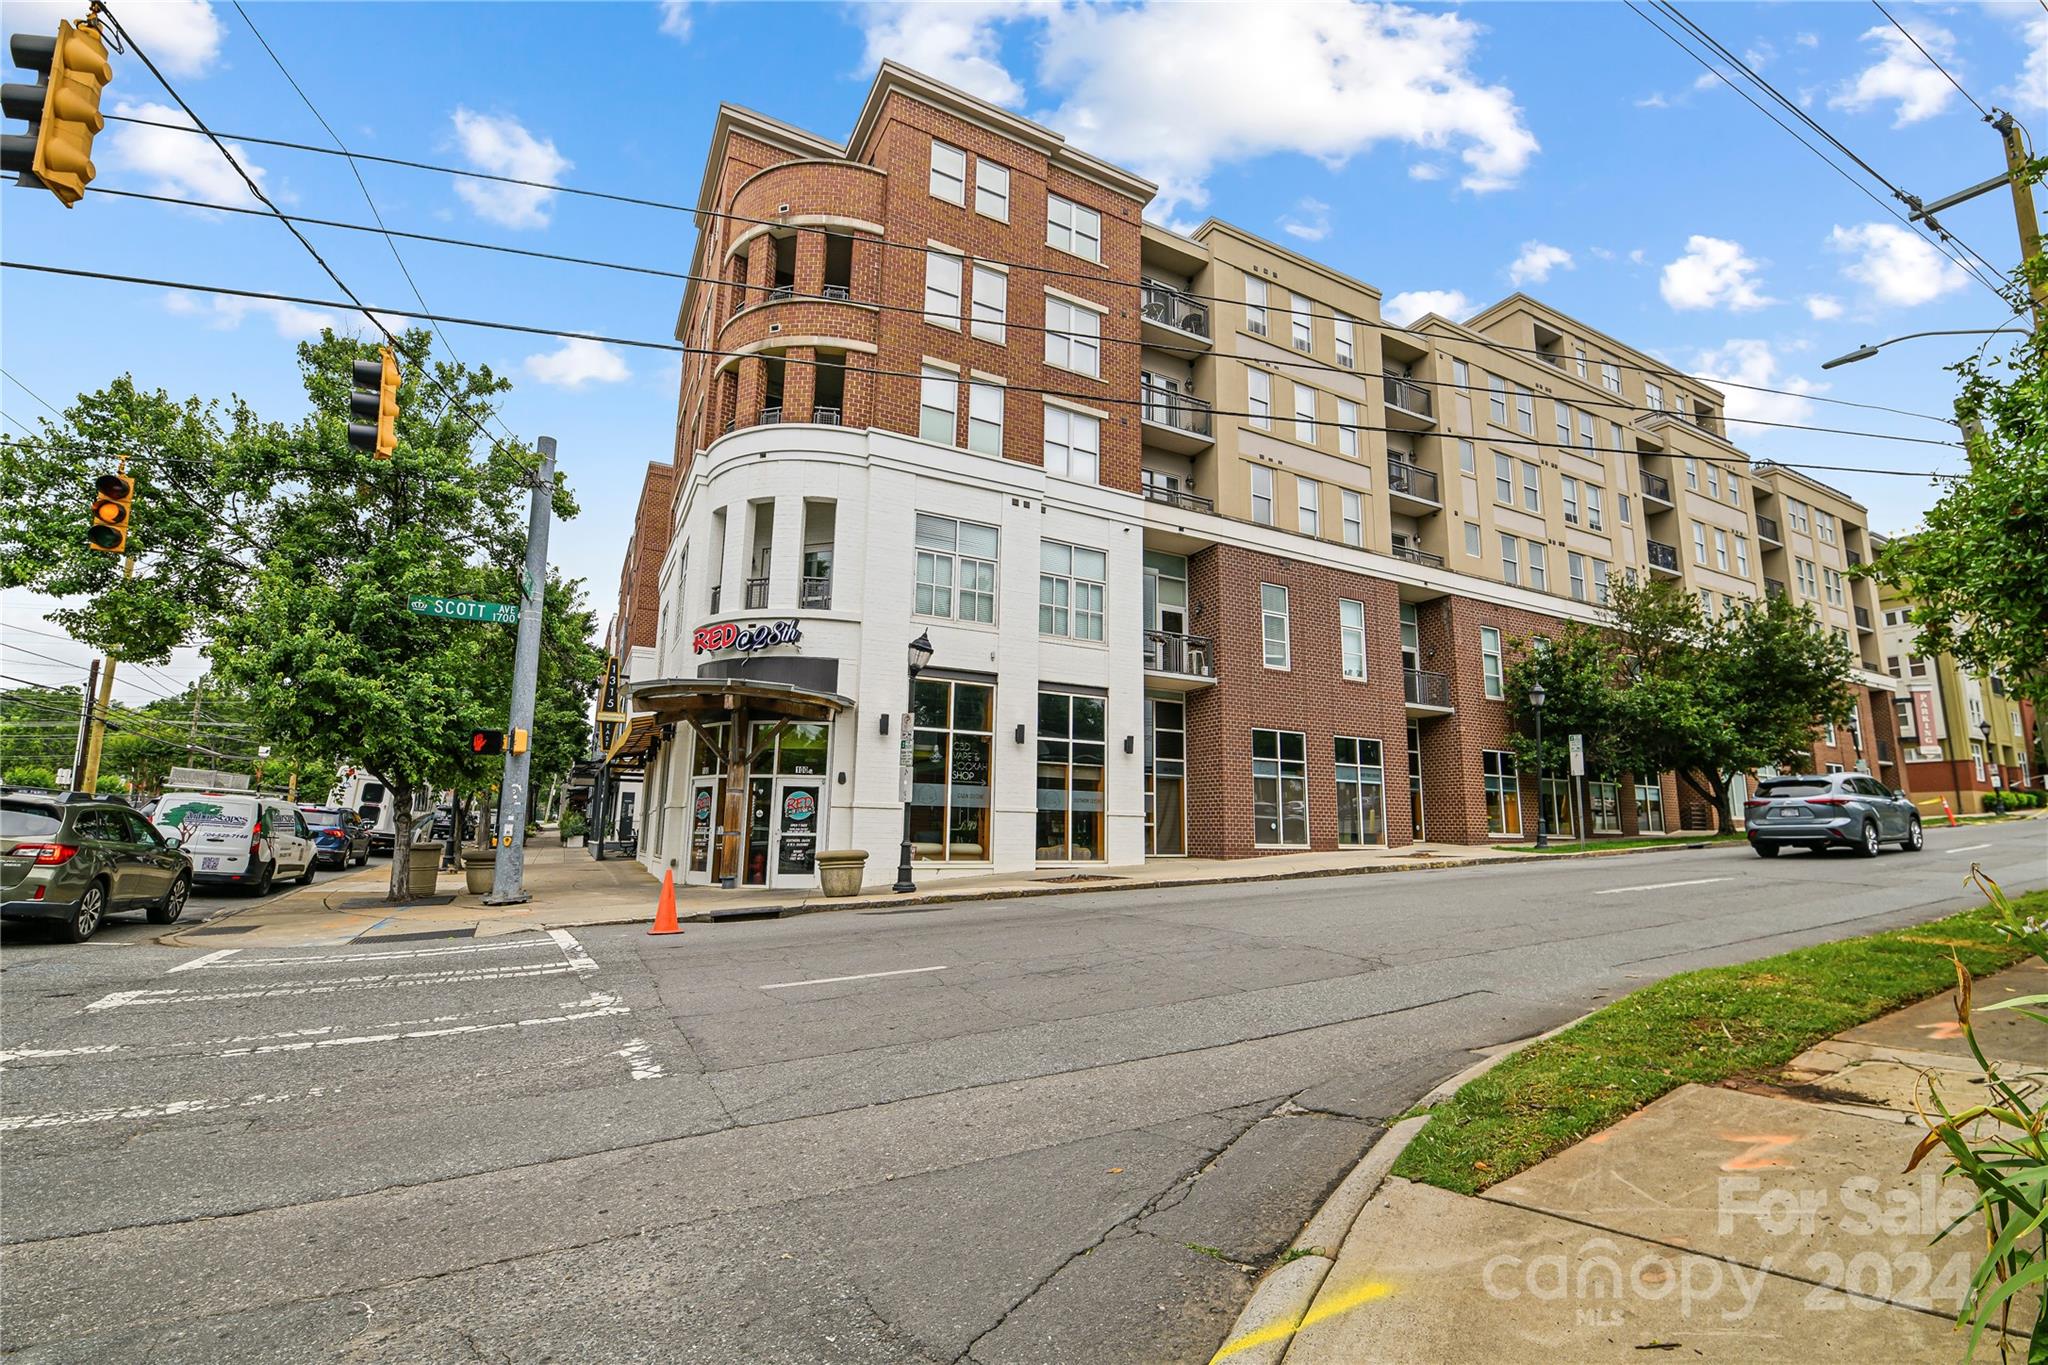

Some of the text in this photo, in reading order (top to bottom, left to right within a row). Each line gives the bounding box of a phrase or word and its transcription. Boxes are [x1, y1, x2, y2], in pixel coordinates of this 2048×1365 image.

[434, 600, 516, 617] SCOTT AVE
[492, 612, 516, 622] 1700
[693, 623, 739, 654] RED
[606, 664, 616, 708] 1315
[1920, 693, 1933, 744] PARKING
[952, 770, 975, 780] SHOP
[787, 796, 813, 810] RED
